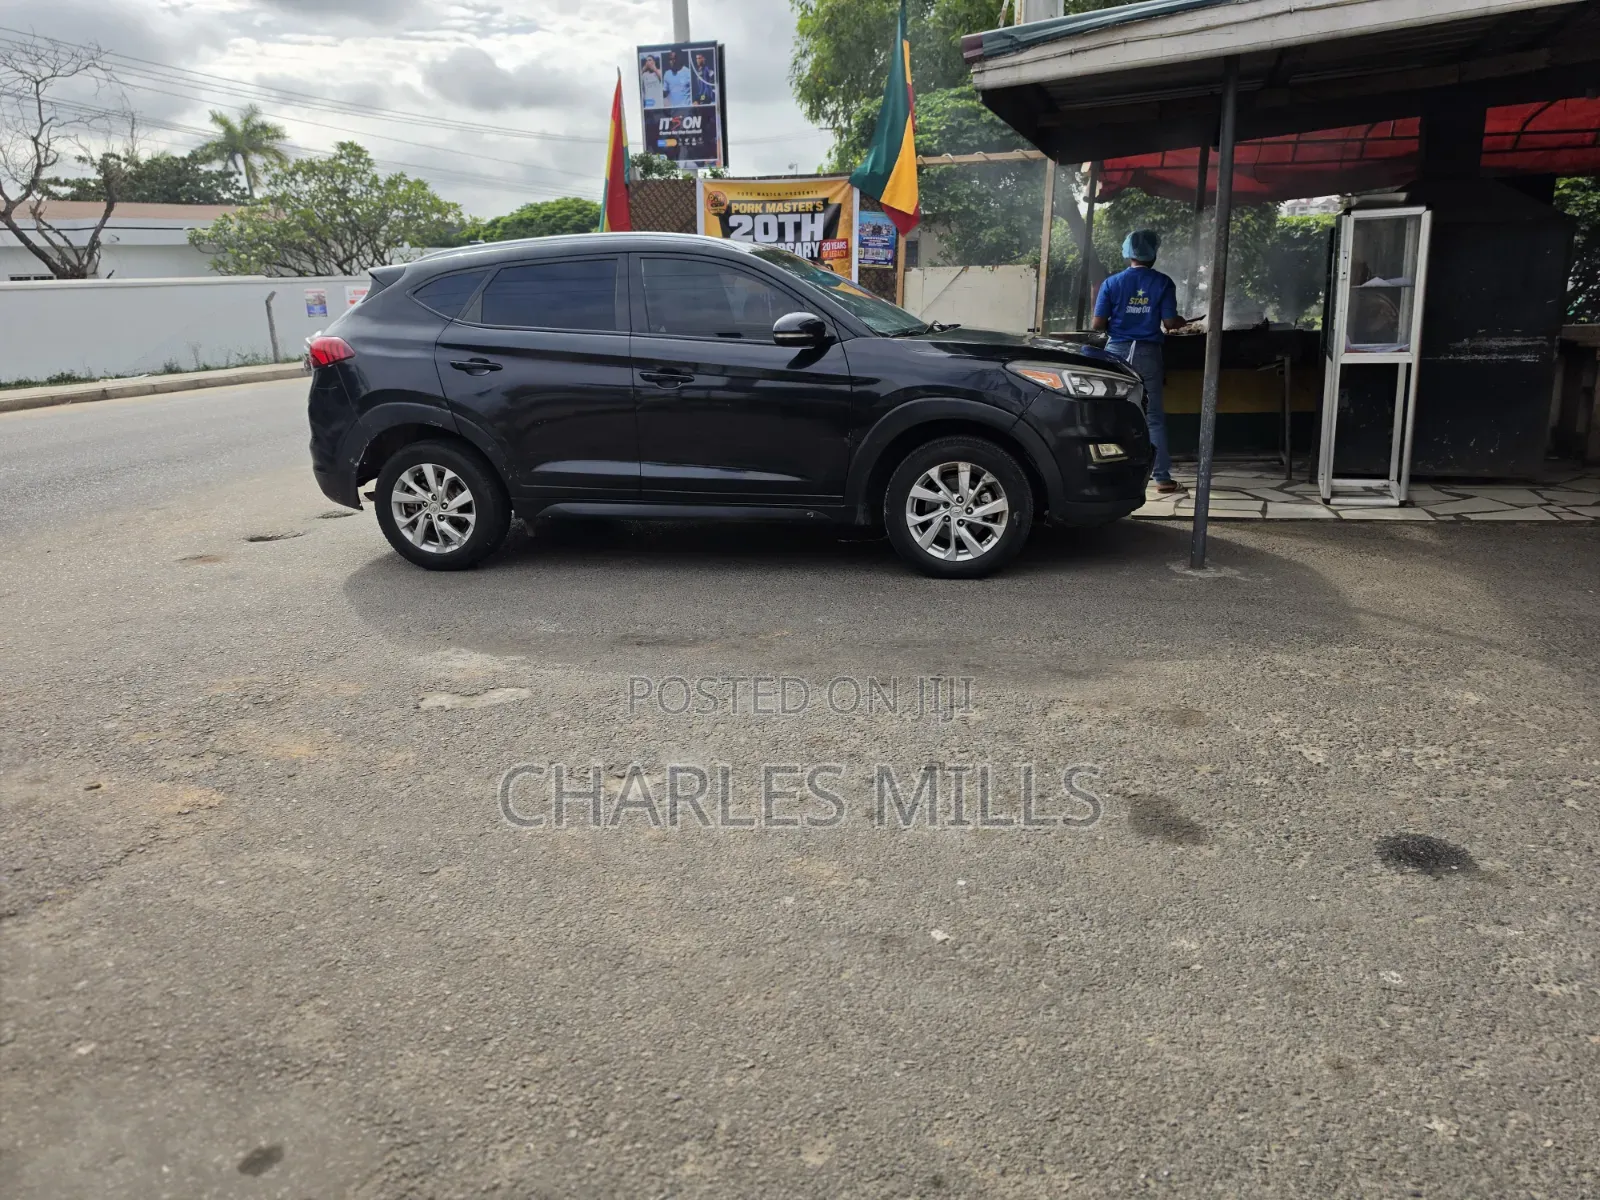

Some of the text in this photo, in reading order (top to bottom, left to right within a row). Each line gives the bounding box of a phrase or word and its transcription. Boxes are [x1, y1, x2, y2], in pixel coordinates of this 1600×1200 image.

[683, 115, 702, 129] ON
[731, 202, 763, 214] PORK
[765, 200, 824, 213] MASTER'S
[728, 213, 825, 242] 20TH
[822, 241, 847, 251] 20 YEARS
[1129, 297, 1149, 305] STAR
